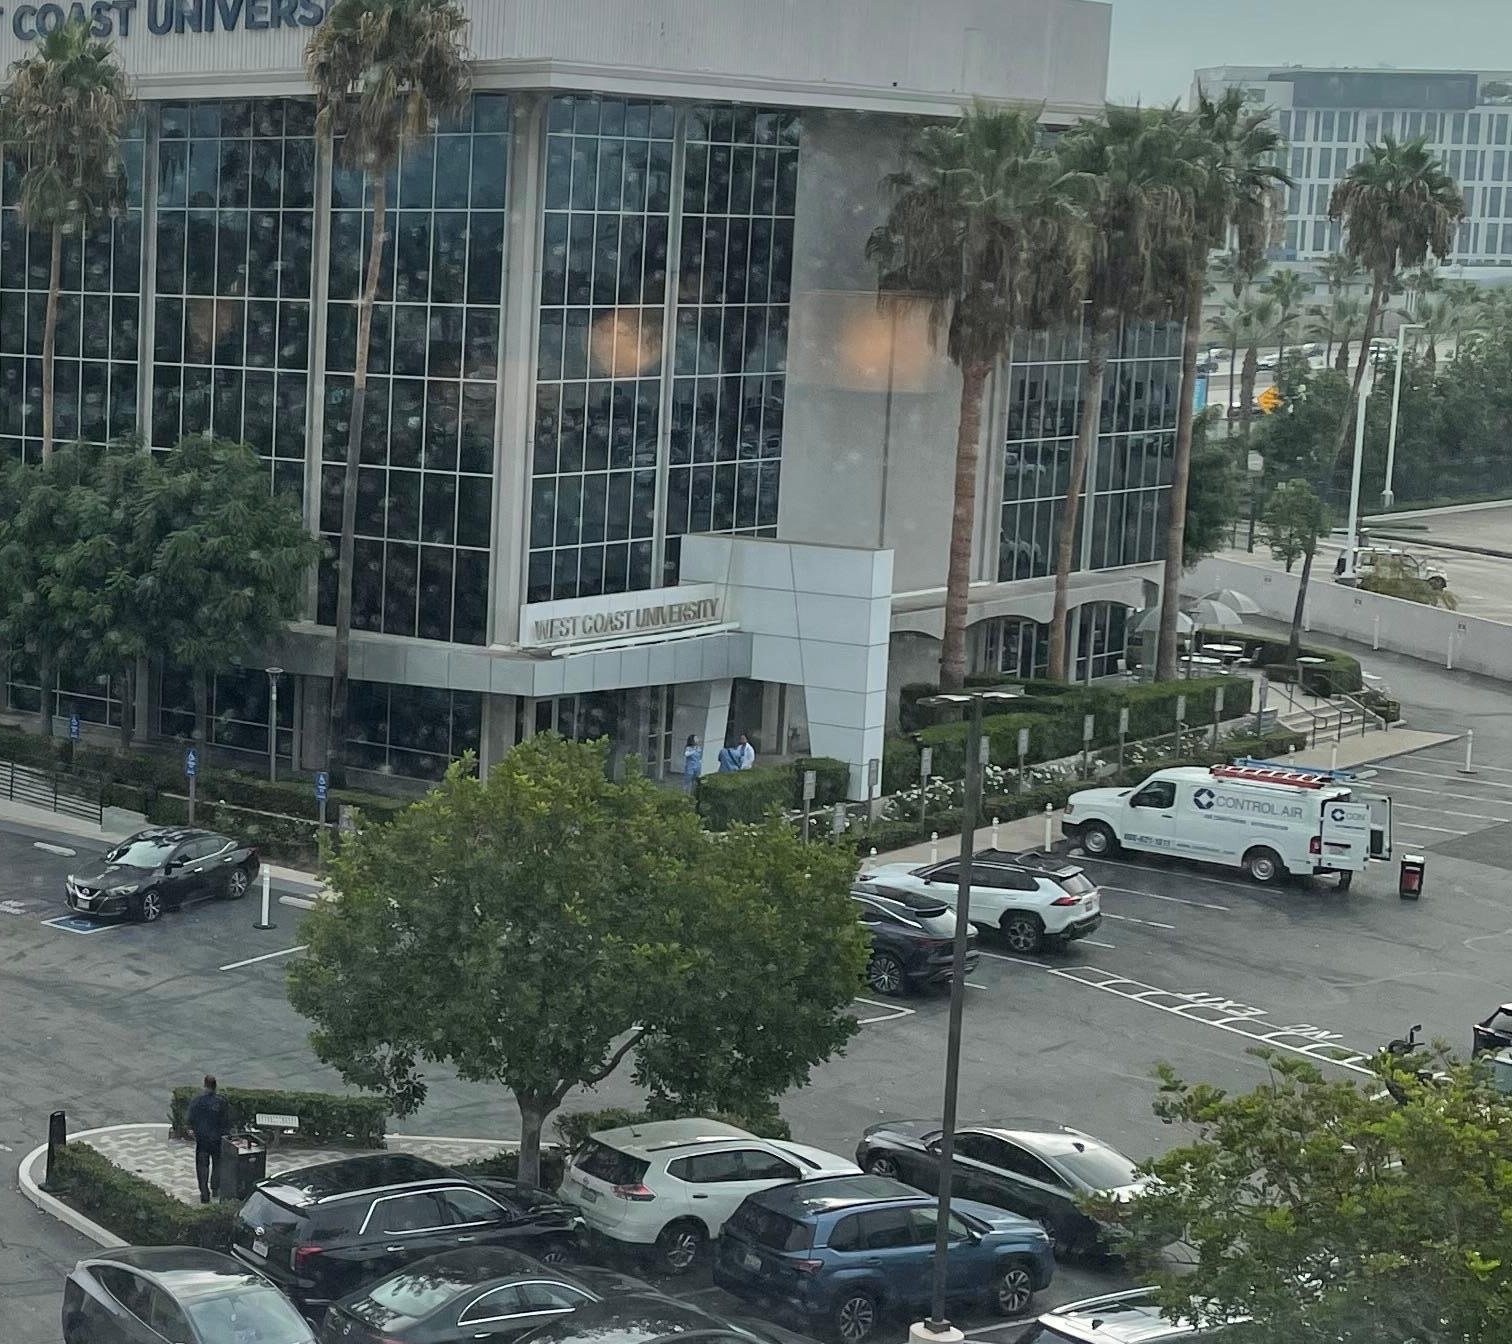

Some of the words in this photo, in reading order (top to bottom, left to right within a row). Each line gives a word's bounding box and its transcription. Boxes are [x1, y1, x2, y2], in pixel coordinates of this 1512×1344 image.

[12, 0, 138, 41] COAST
[534, 615, 581, 641] WEST
[581, 610, 635, 635] COAST
[635, 598, 720, 628] UNIVERSITY
[1216, 795, 1281, 816] CONTROL
[1280, 805, 1304, 820] AIR
